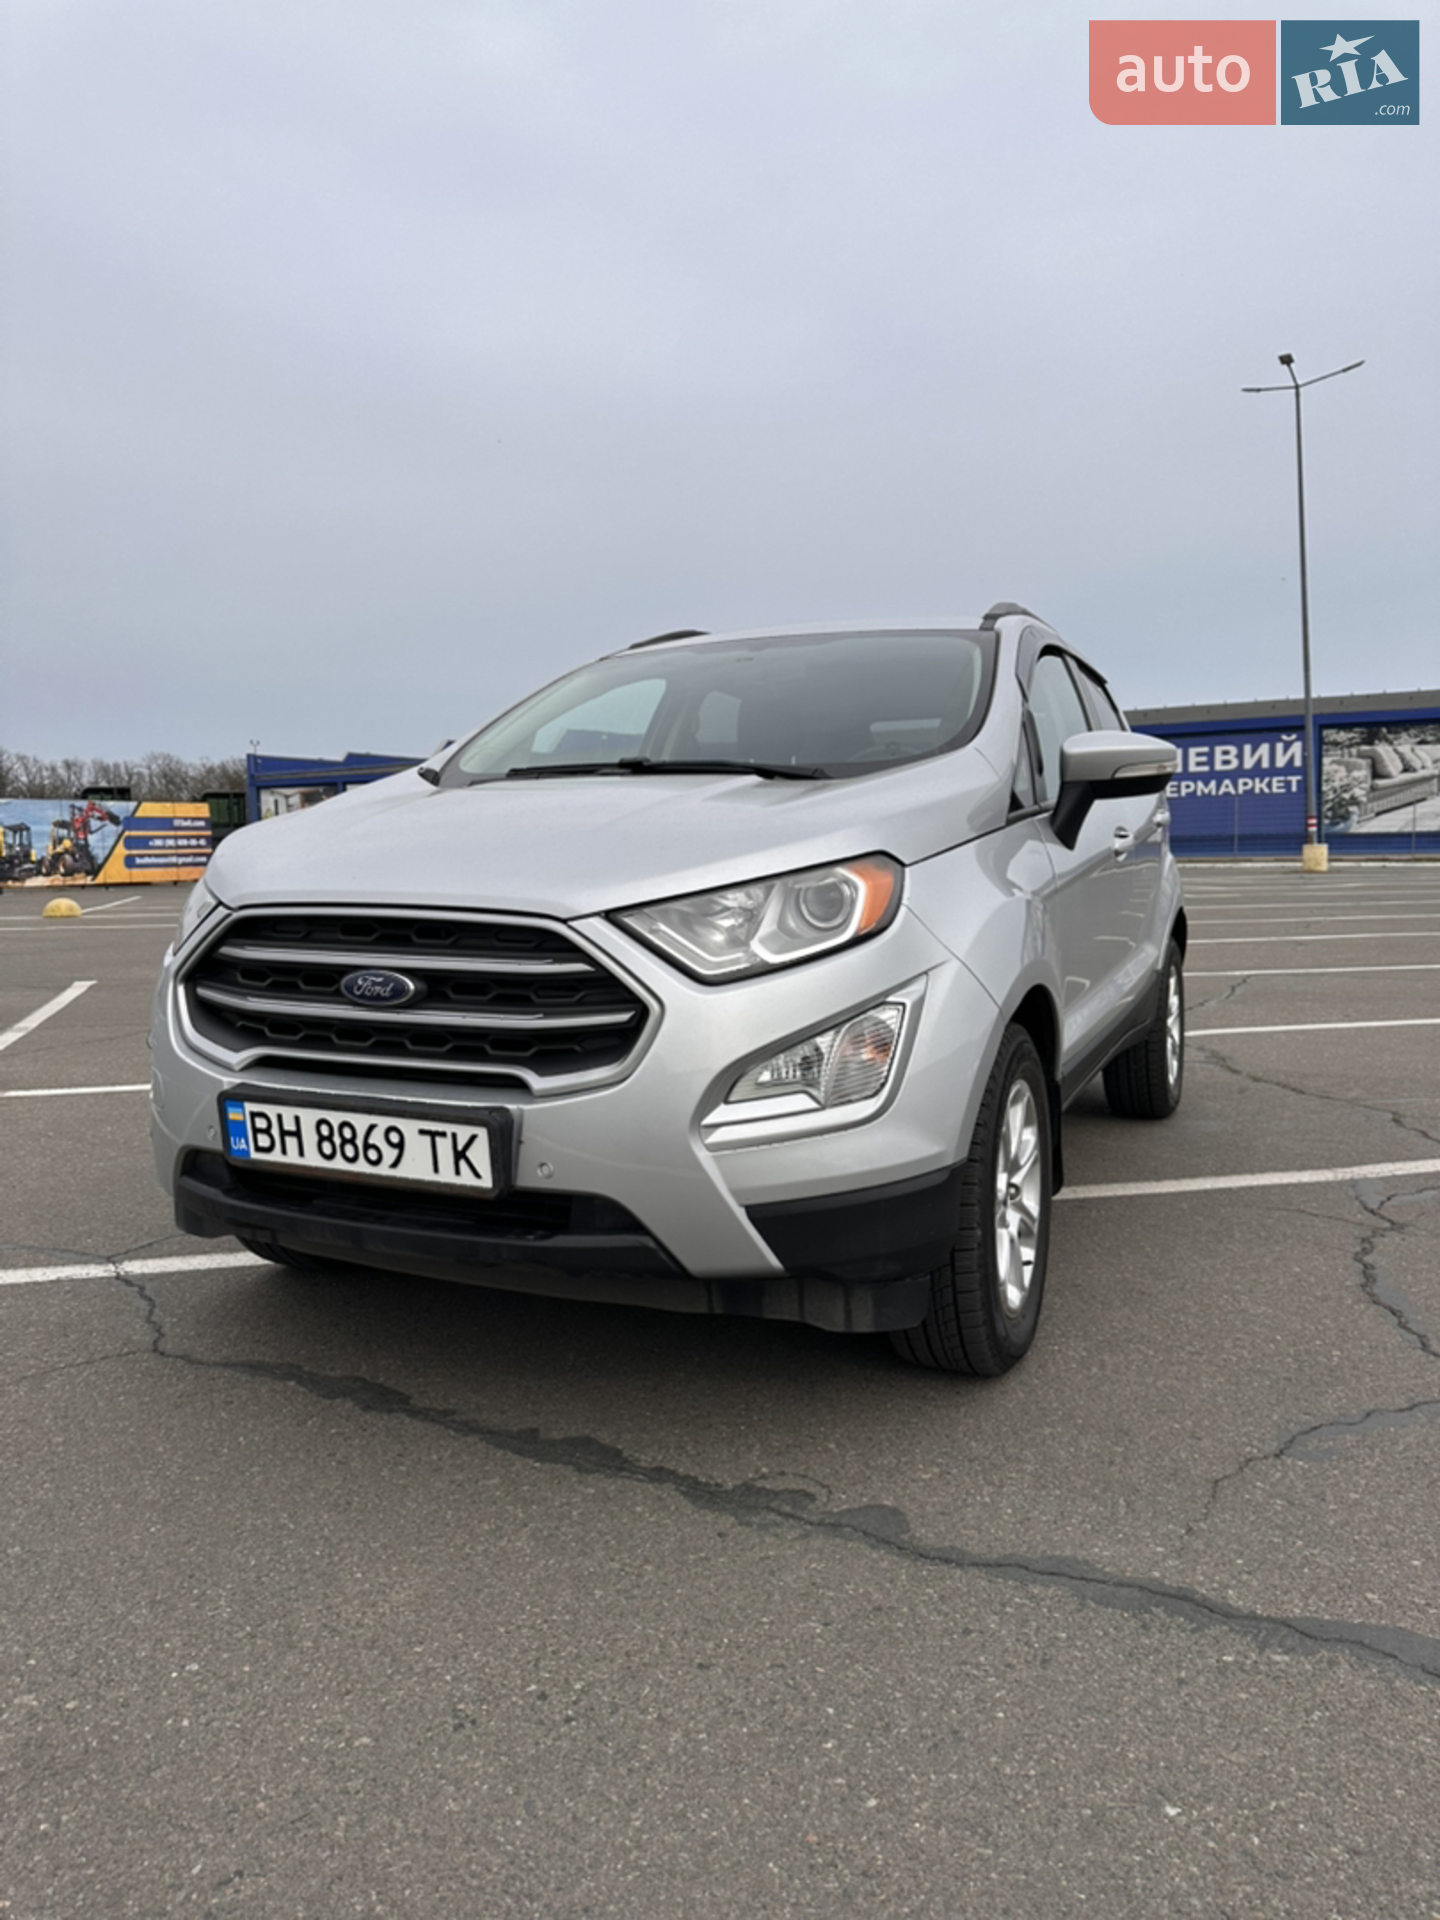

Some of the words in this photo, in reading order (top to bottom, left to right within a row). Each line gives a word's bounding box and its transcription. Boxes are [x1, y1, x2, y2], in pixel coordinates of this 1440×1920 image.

[1175, 733, 1303, 773] ЕВИЙ
[353, 975, 395, 997] Ford
[230, 1137, 248, 1151] UA
[249, 1110, 305, 1158] BH
[314, 1118, 405, 1169] 8869
[418, 1128, 482, 1179] TK
